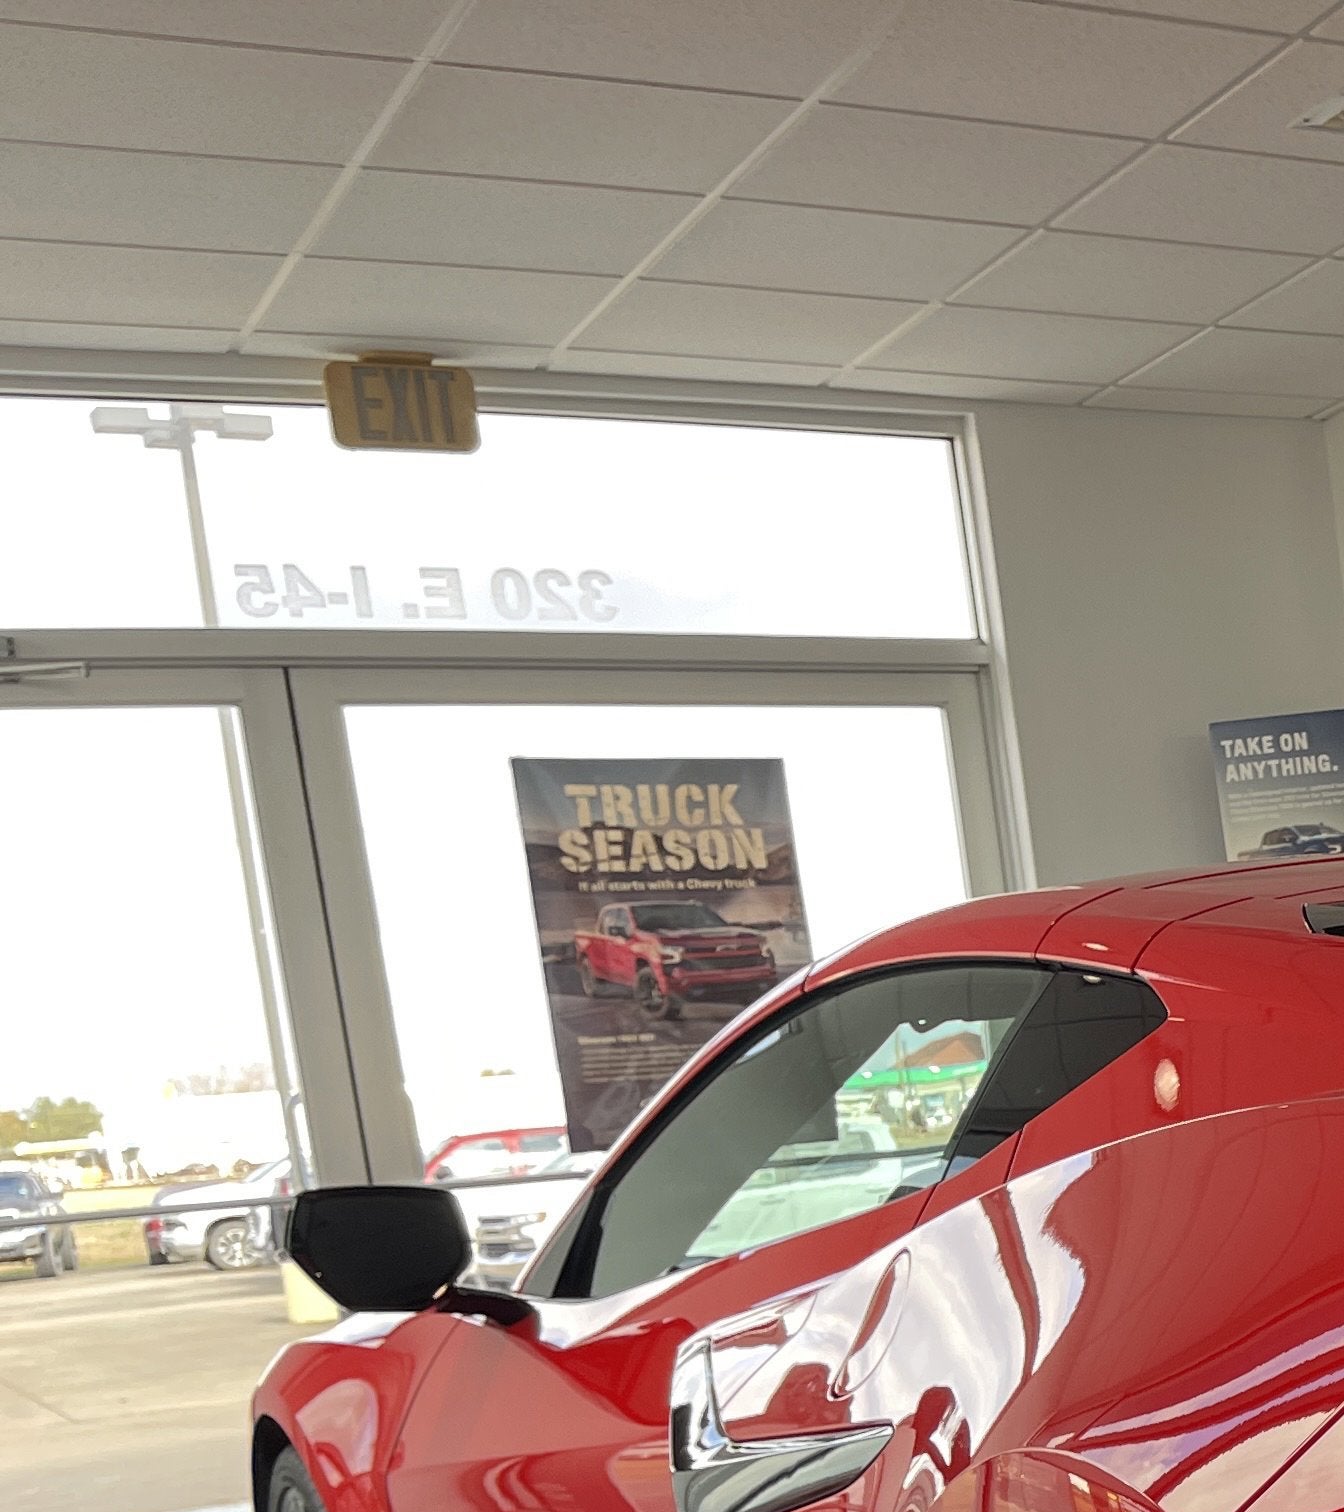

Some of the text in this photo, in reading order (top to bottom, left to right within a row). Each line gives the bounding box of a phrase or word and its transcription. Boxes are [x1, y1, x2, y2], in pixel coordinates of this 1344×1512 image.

[351, 366, 458, 445] EXIT
[1220, 732, 1309, 758] TAKE ON
[1225, 754, 1339, 783] ANYTHING.
[563, 783, 745, 828] TRUCK
[557, 828, 769, 873] SEASON
[647, 879, 675, 890] with
[686, 878, 722, 891] Chevy
